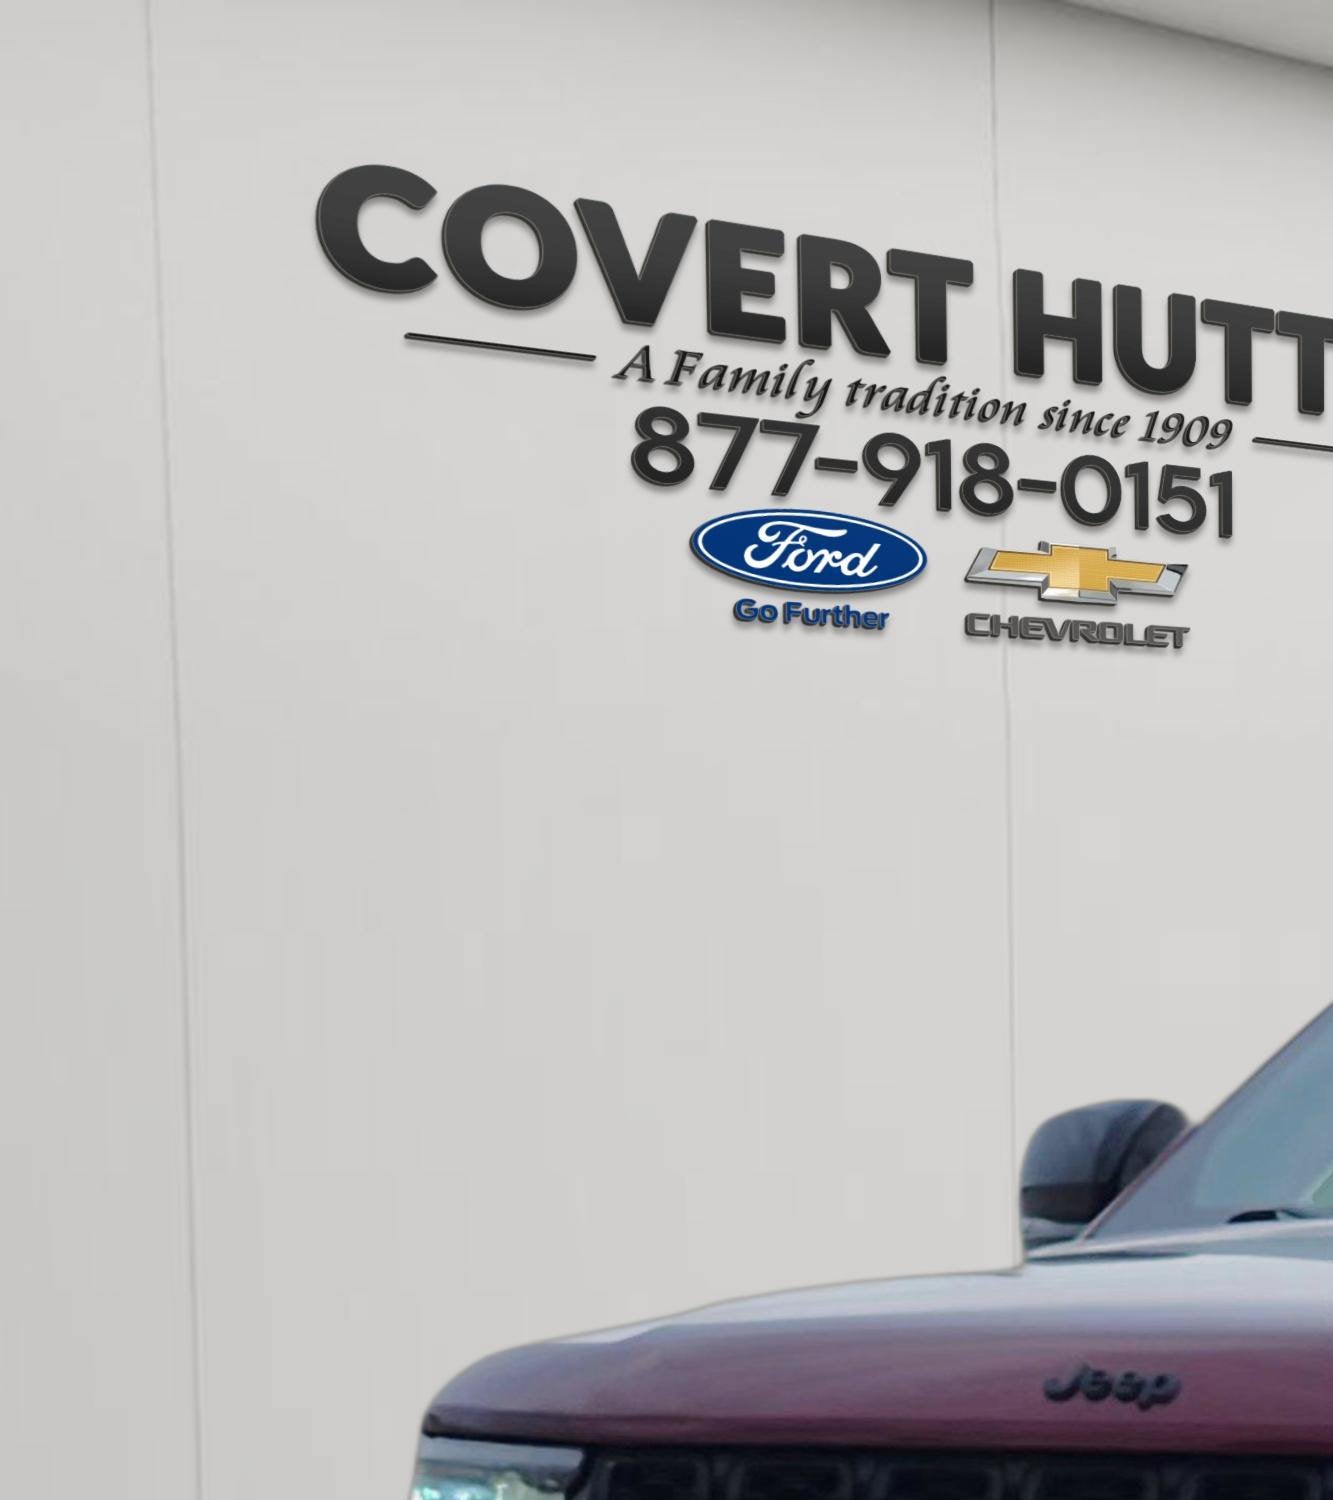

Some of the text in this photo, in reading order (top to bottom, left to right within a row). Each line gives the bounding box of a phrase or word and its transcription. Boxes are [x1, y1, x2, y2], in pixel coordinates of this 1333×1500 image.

[315, 164, 974, 365] COVERT
[611, 345, 1233, 451] A Family tradition since 1909
[630, 405, 1233, 539] 877-918-0151
[743, 519, 882, 578] Ford
[733, 598, 890, 631] Go Further
[963, 612, 1191, 650] CHEVROLET
[1043, 1360, 1182, 1412] Jeep
